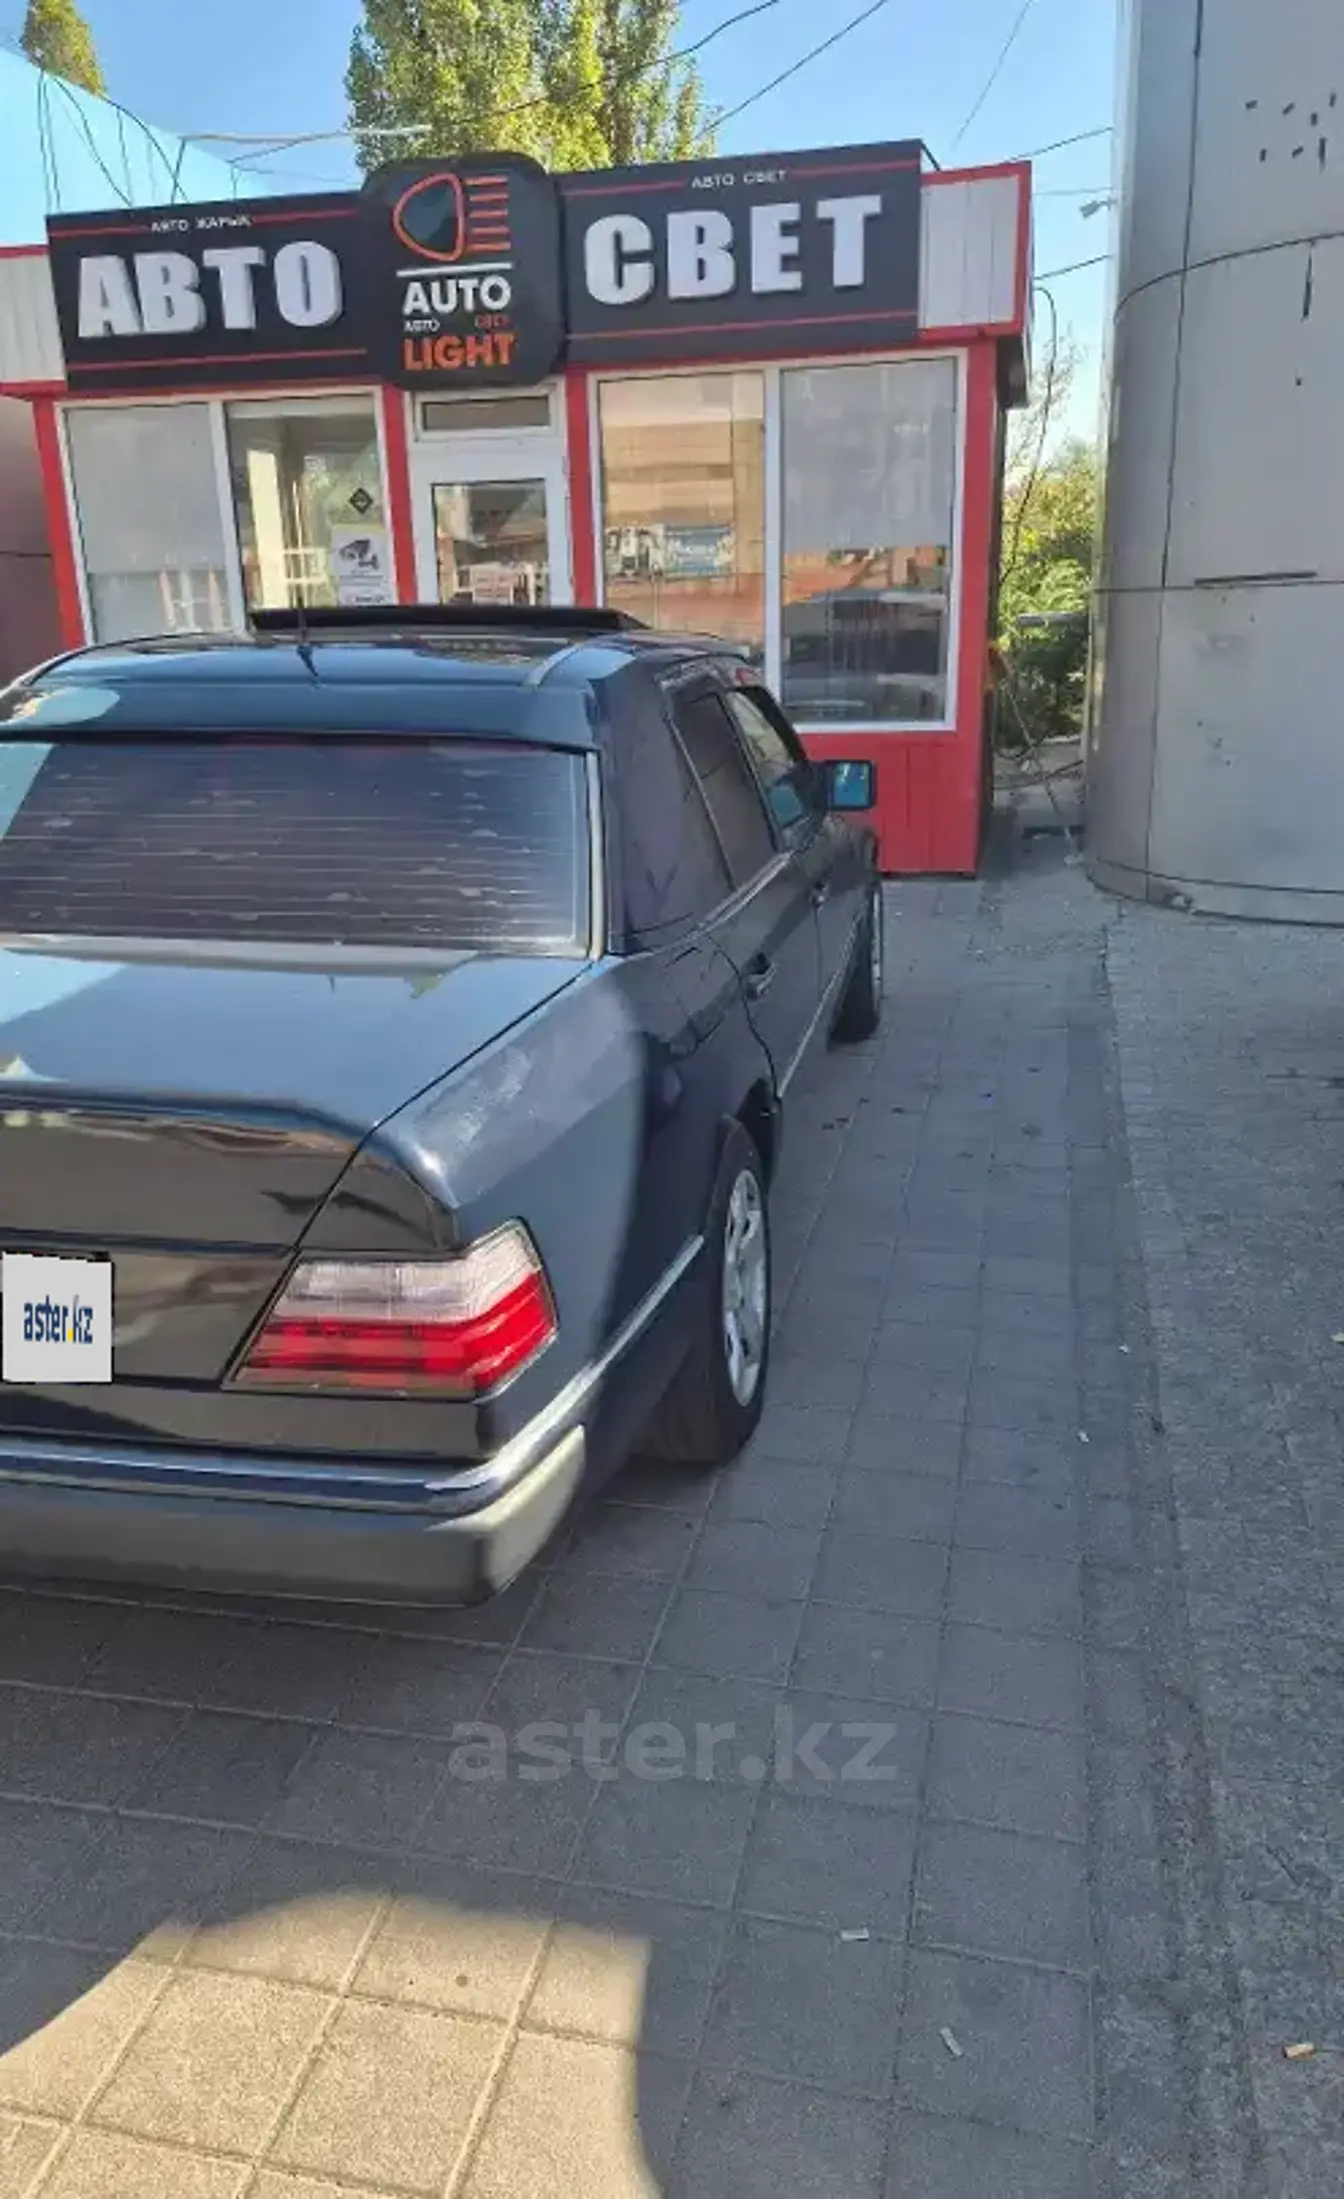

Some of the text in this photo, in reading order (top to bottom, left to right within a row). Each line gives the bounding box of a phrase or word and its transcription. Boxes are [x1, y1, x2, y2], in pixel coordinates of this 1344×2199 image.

[692, 169, 786, 189] АВТО СВЕТ
[151, 218, 189, 233] АВТО
[584, 195, 883, 305] СВЕТ
[78, 241, 343, 338] АВТО
[403, 274, 512, 315] AUTO
[403, 333, 516, 370] LIGHT
